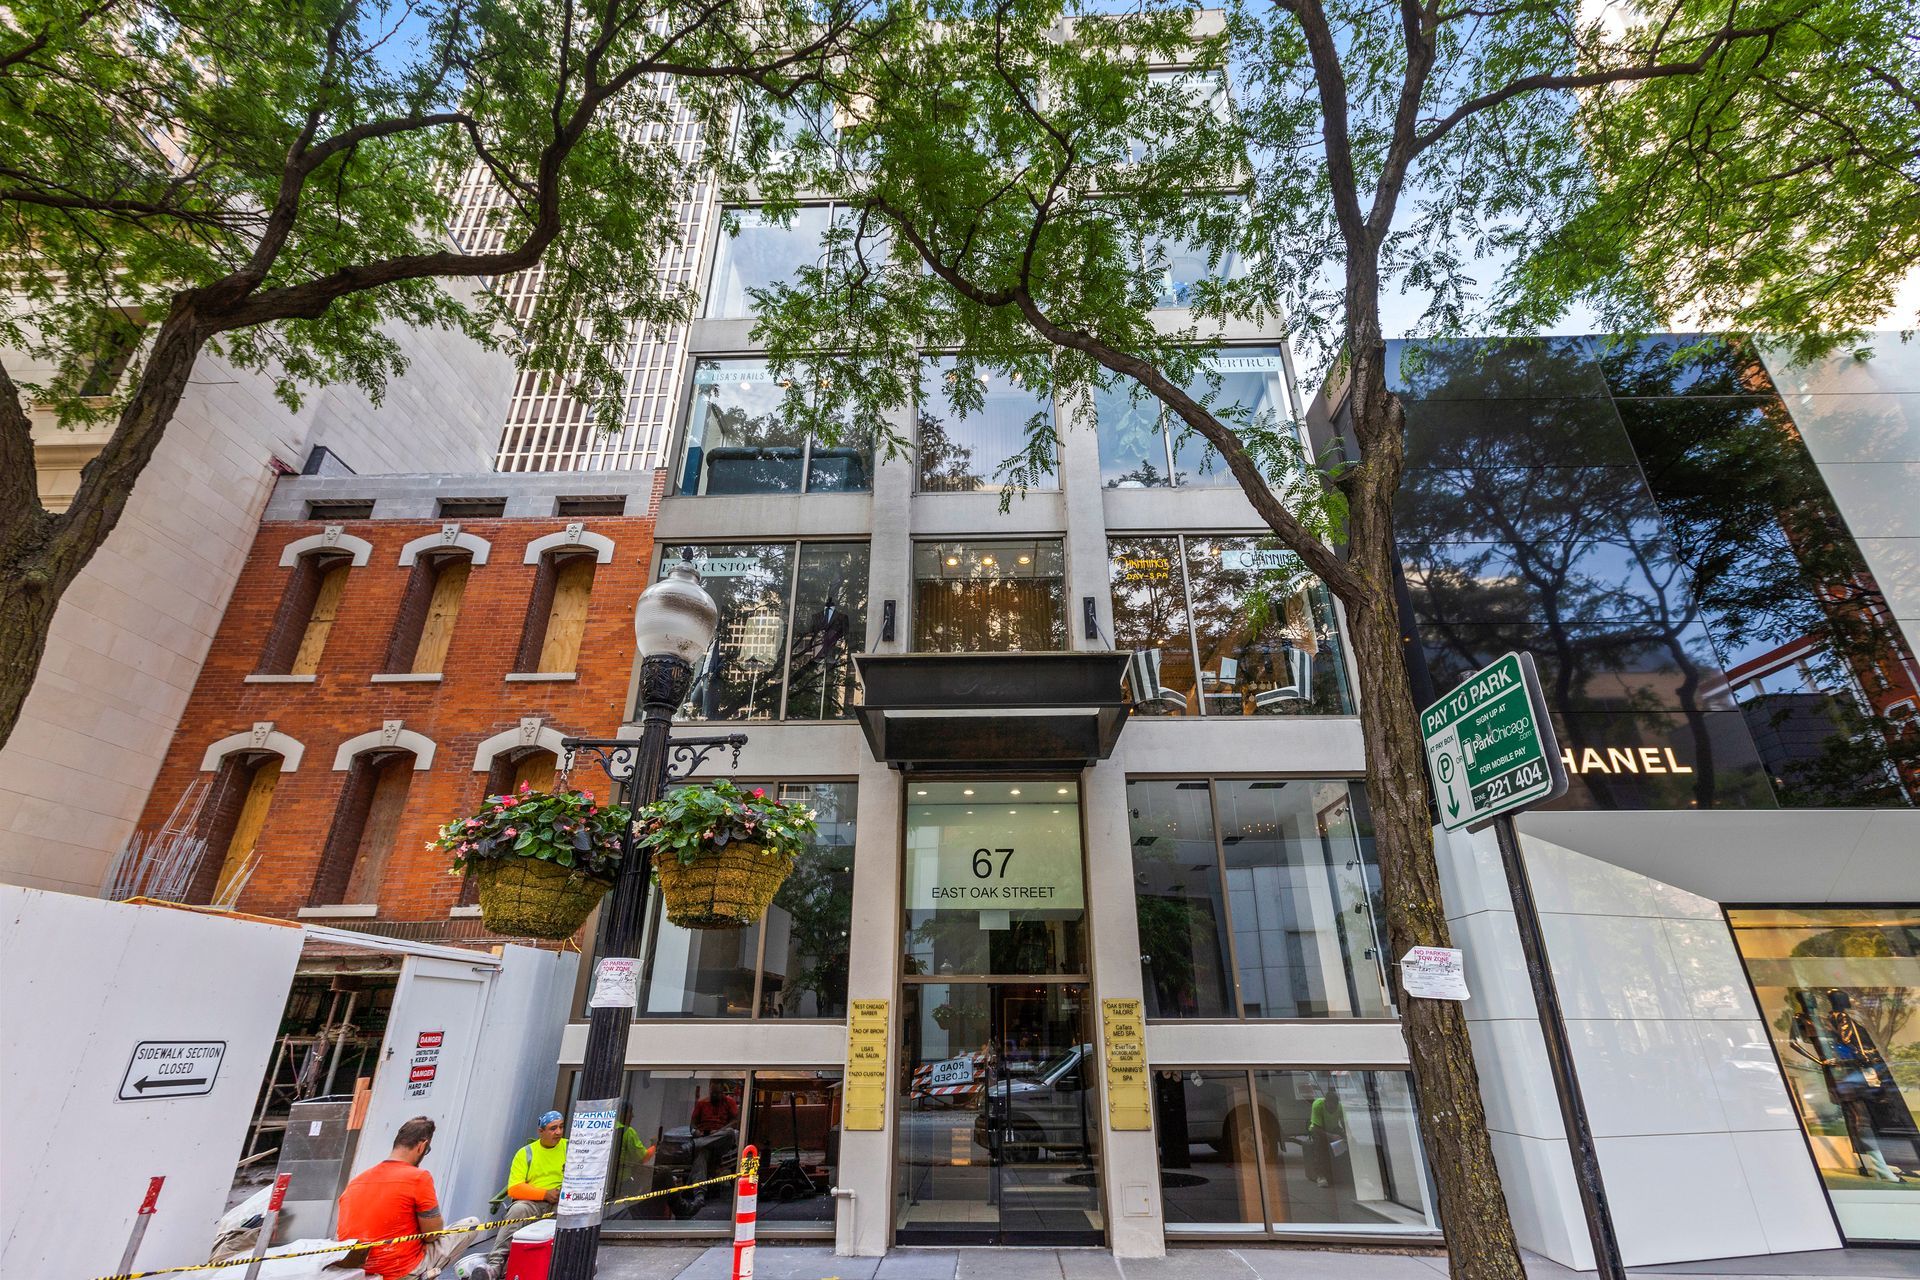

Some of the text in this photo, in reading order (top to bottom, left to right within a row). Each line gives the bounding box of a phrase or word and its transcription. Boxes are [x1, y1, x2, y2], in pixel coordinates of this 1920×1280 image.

[1202, 358, 1276, 367] VERTRUE
[711, 372, 764, 381] LISA'S NAILS
[702, 562, 757, 572] CUSTOM
[1427, 665, 1513, 733] PAY TO PARK
[1475, 703, 1506, 726] SIGN UP AT
[1430, 735, 1455, 753] AT PAY BOX
[1455, 755, 1463, 765] OR
[1479, 746, 1527, 775] FOR MOBILE PAY
[1560, 748, 1693, 774] HANEL
[1474, 762, 1543, 803] ZONE 221 404
[972, 848, 1015, 879] 67
[932, 886, 1055, 899] EAST OAK STREET
[420, 1036, 441, 1044] DANGER
[137, 1047, 222, 1060] SIDEWALK SECTION
[158, 1062, 194, 1075] CLOSED
[412, 1069, 435, 1078] DANGER
[573, 1120, 612, 1129] OW ZONE
[572, 1192, 597, 1201] CHICAGO
